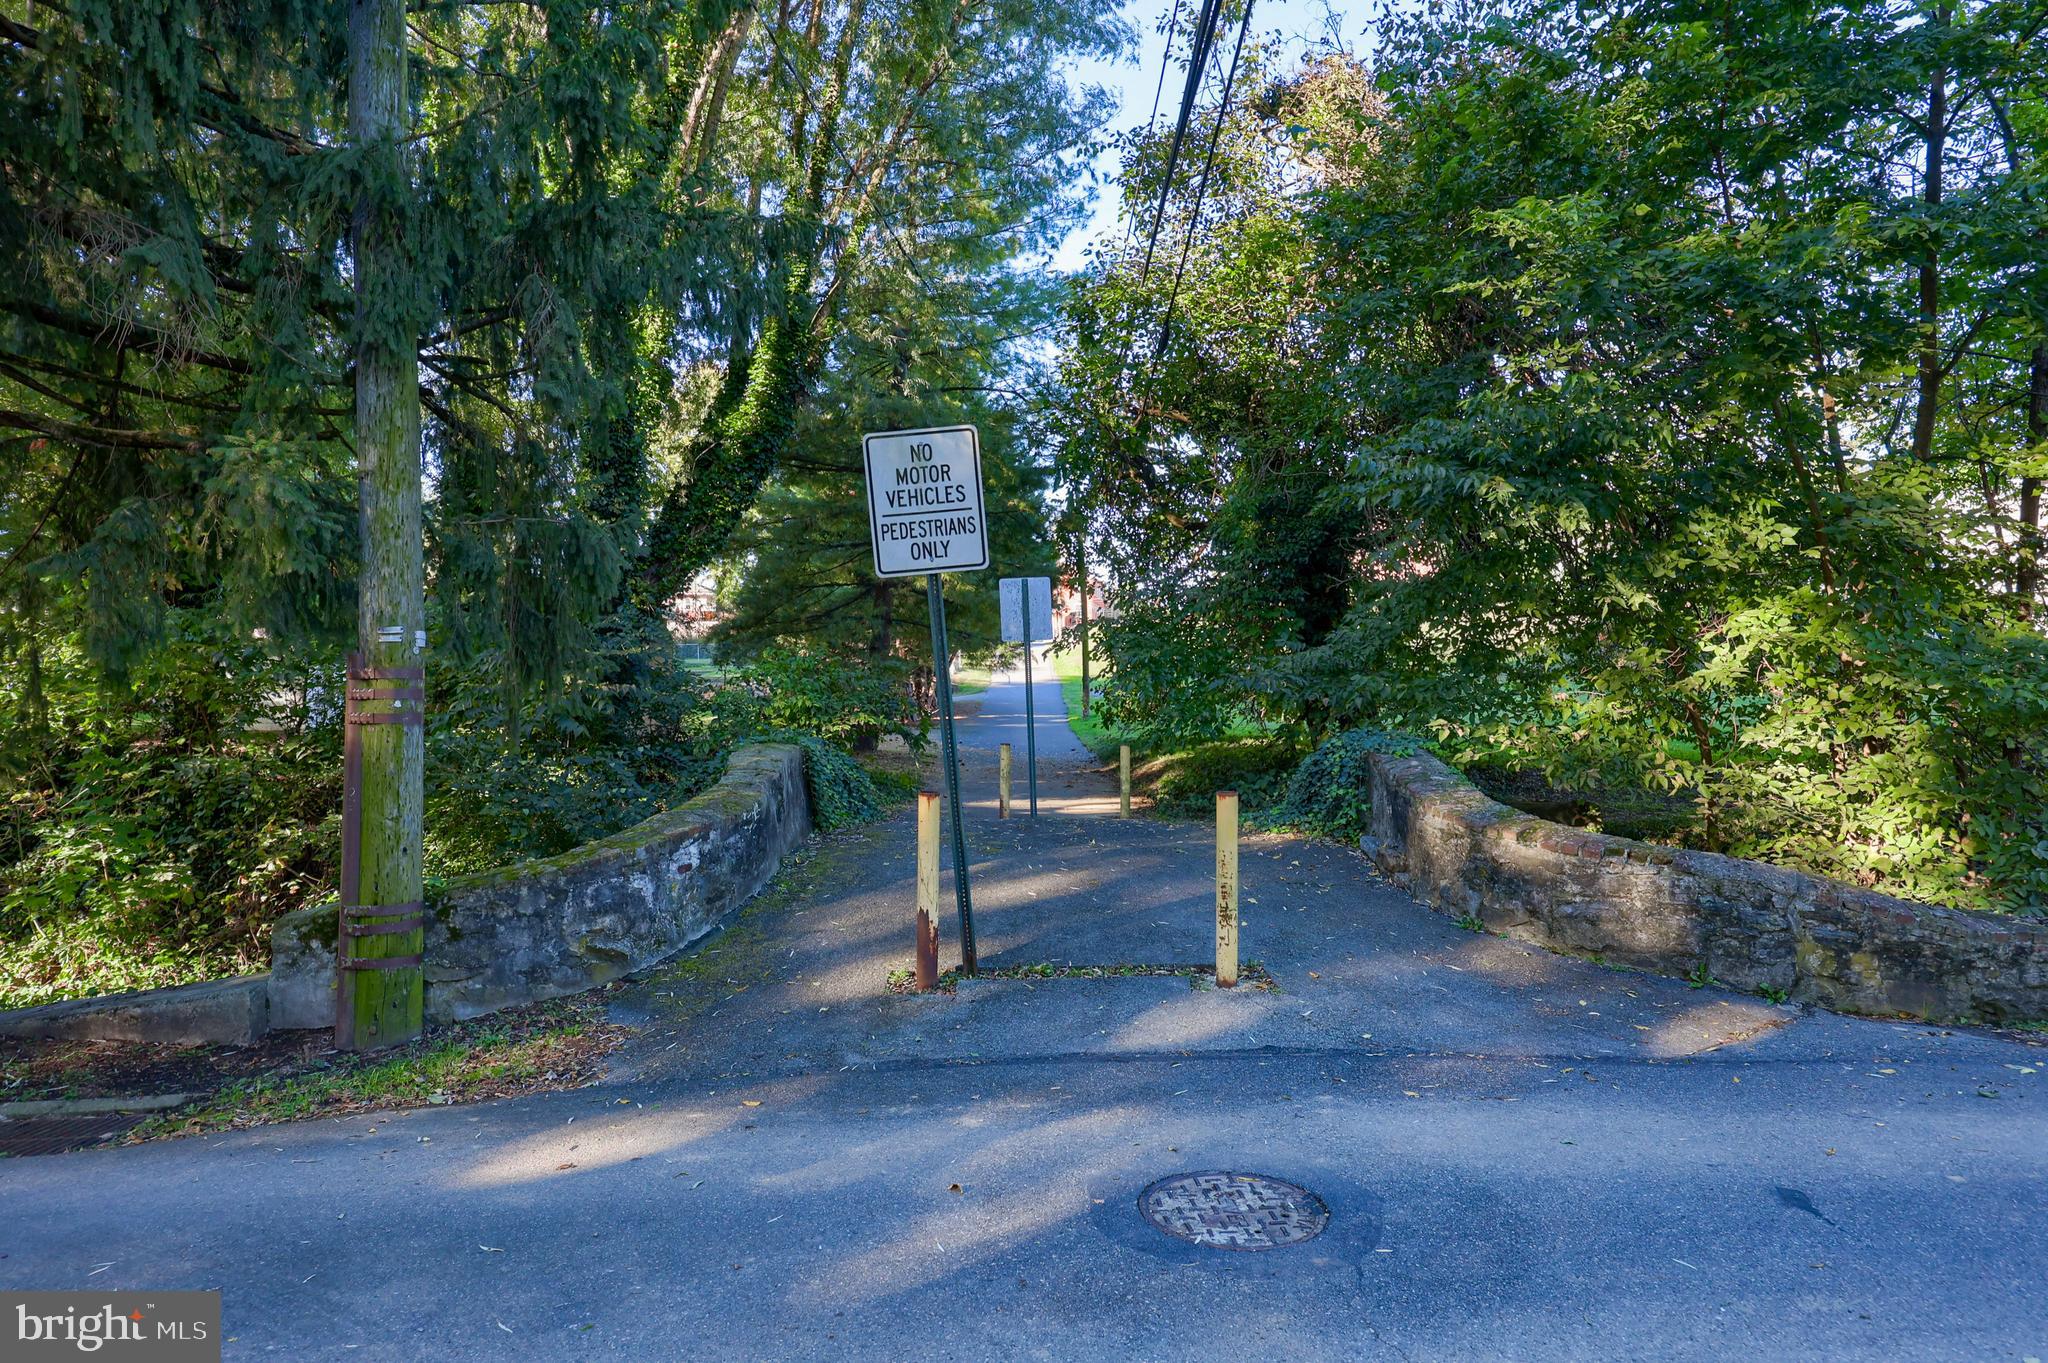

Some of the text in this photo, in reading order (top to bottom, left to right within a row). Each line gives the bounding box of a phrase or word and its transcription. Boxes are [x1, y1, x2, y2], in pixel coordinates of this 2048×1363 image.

[910, 443, 932, 462] NO
[895, 464, 951, 485] MOTOR
[885, 485, 966, 508] VEHICLES
[881, 516, 976, 541] PEDESTRIANS
[910, 540, 950, 561] ONLY
